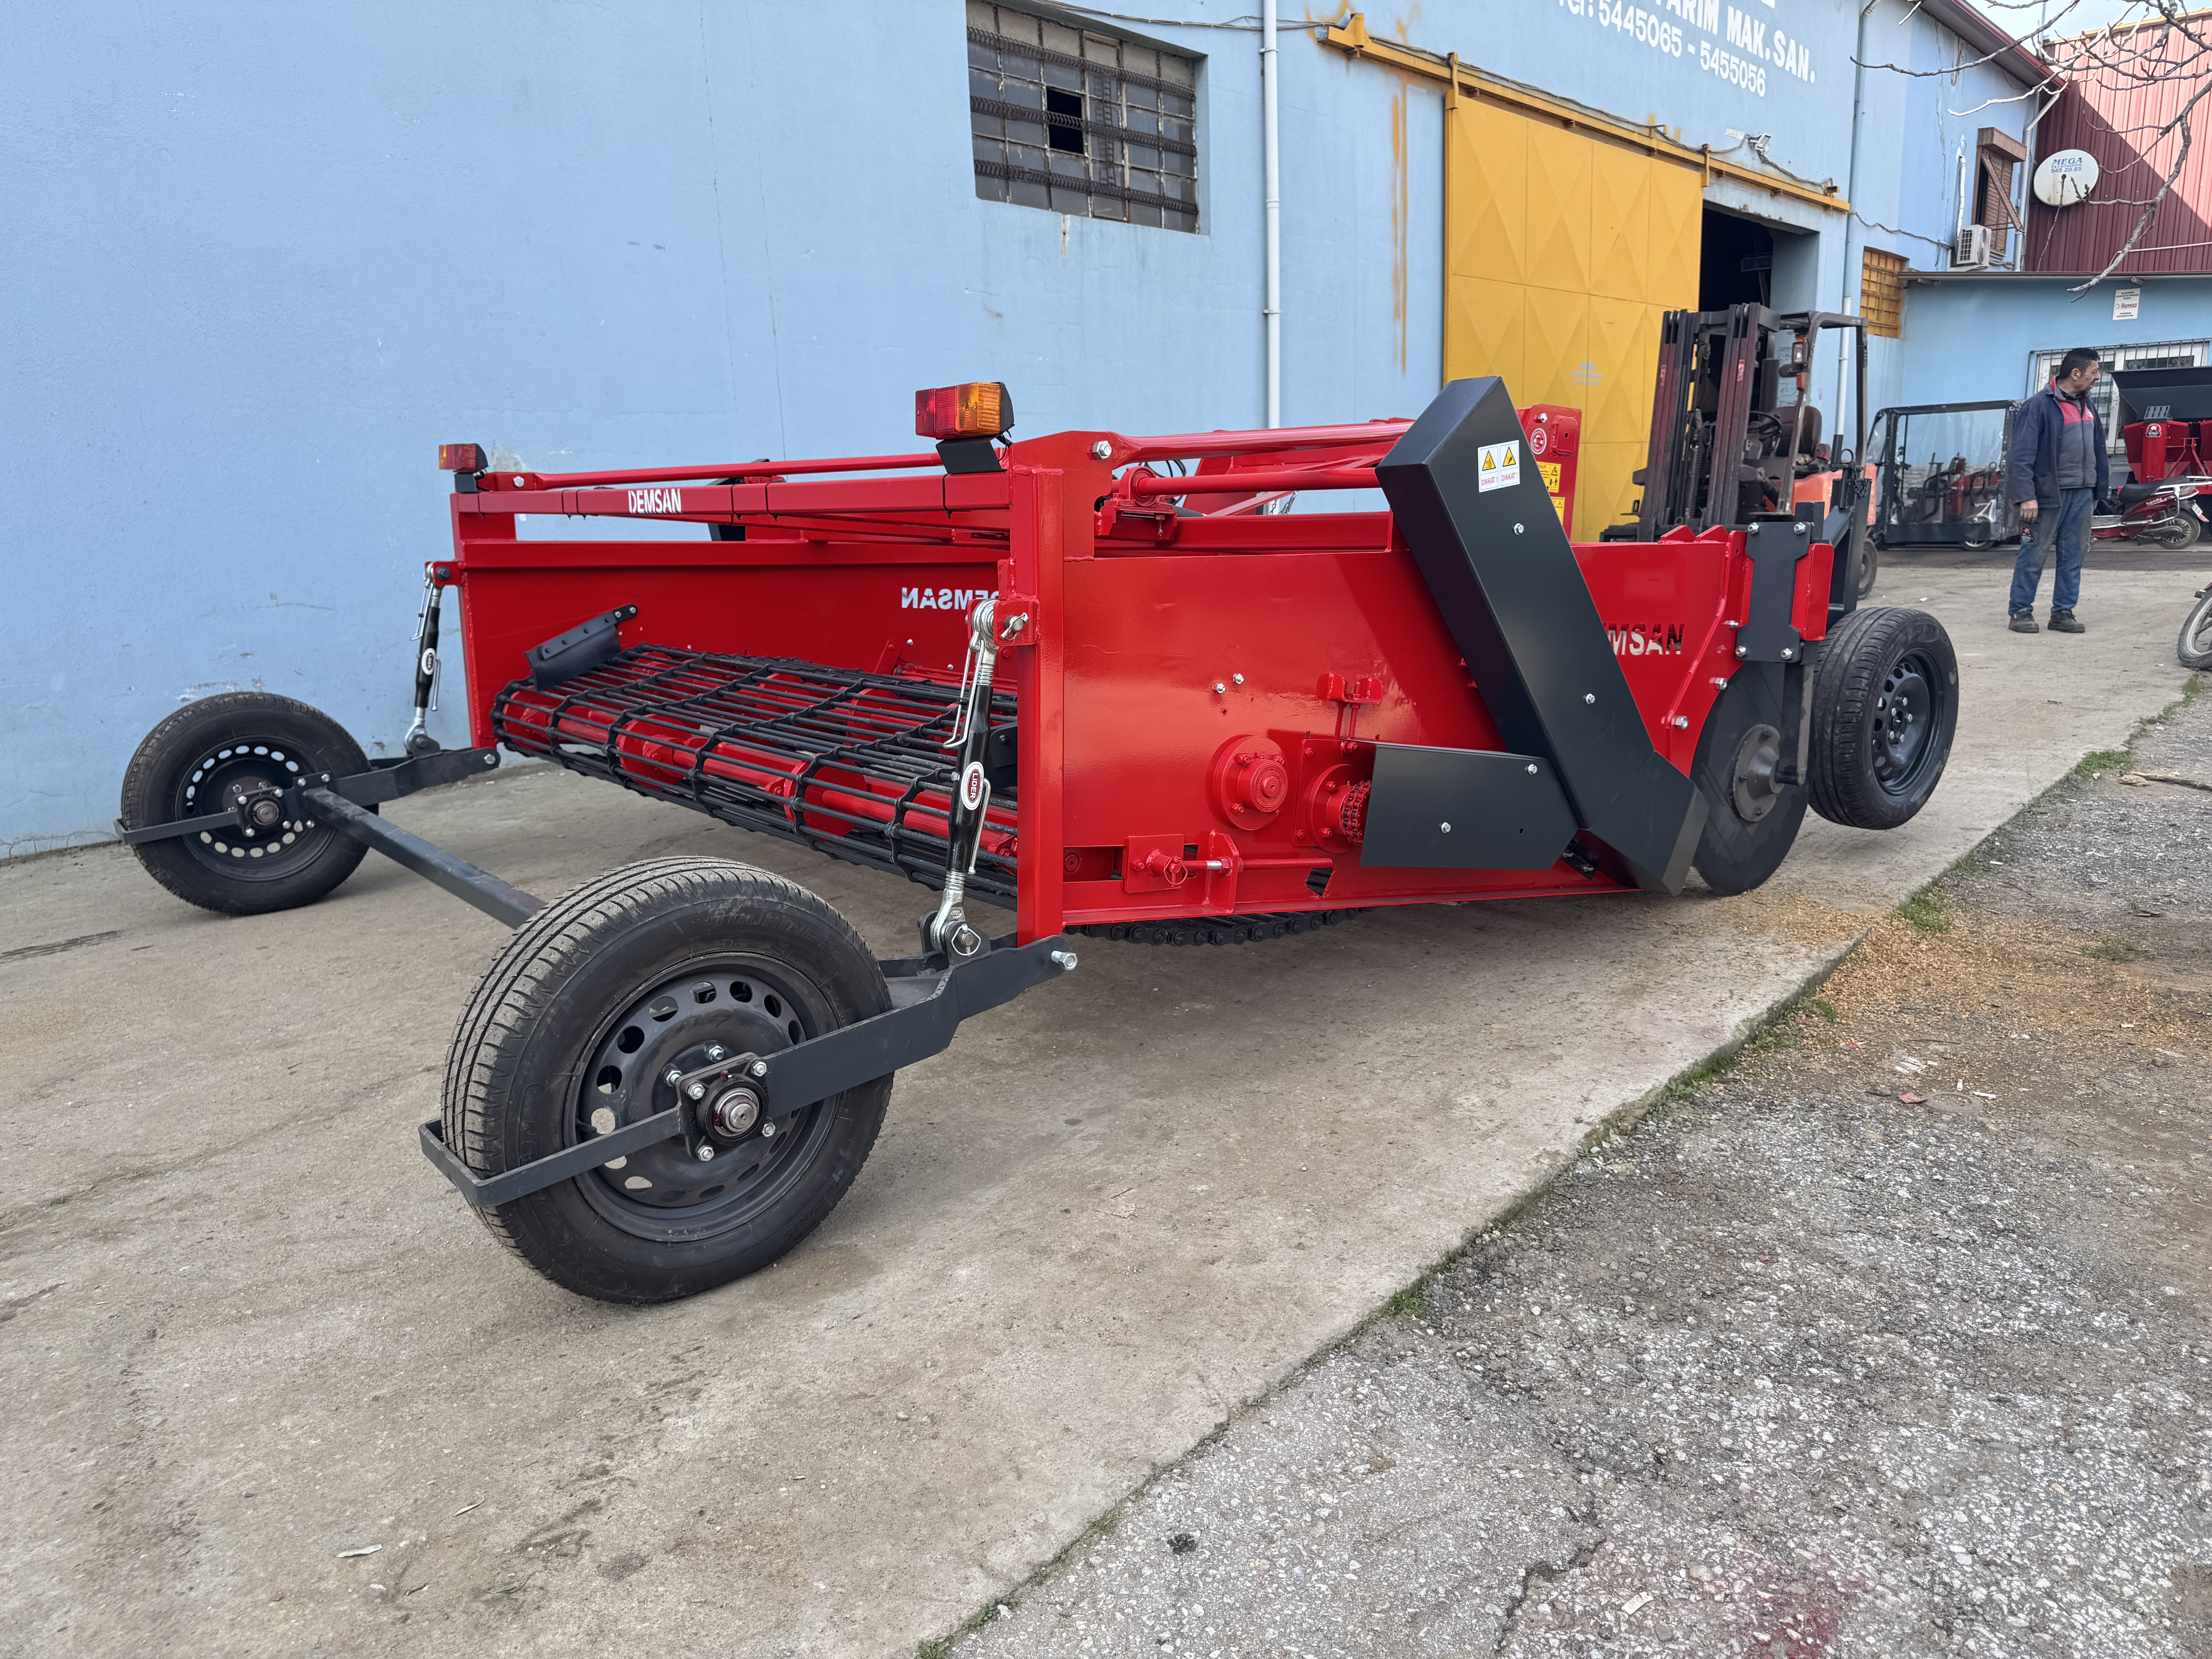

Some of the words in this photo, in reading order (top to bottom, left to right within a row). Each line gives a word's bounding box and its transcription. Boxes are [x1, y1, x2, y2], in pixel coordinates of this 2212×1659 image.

[1655, 0, 1719, 35] RIM
[1559, 0, 1594, 17] el:
[1599, 0, 1682, 58] 5445065
[1700, 41, 1766, 97] 5455056
[2052, 157, 2082, 165] MEGA
[628, 488, 682, 514] DEMSAN
[1603, 623, 1685, 656] MSAN
[713, 913, 819, 943] TOURING
